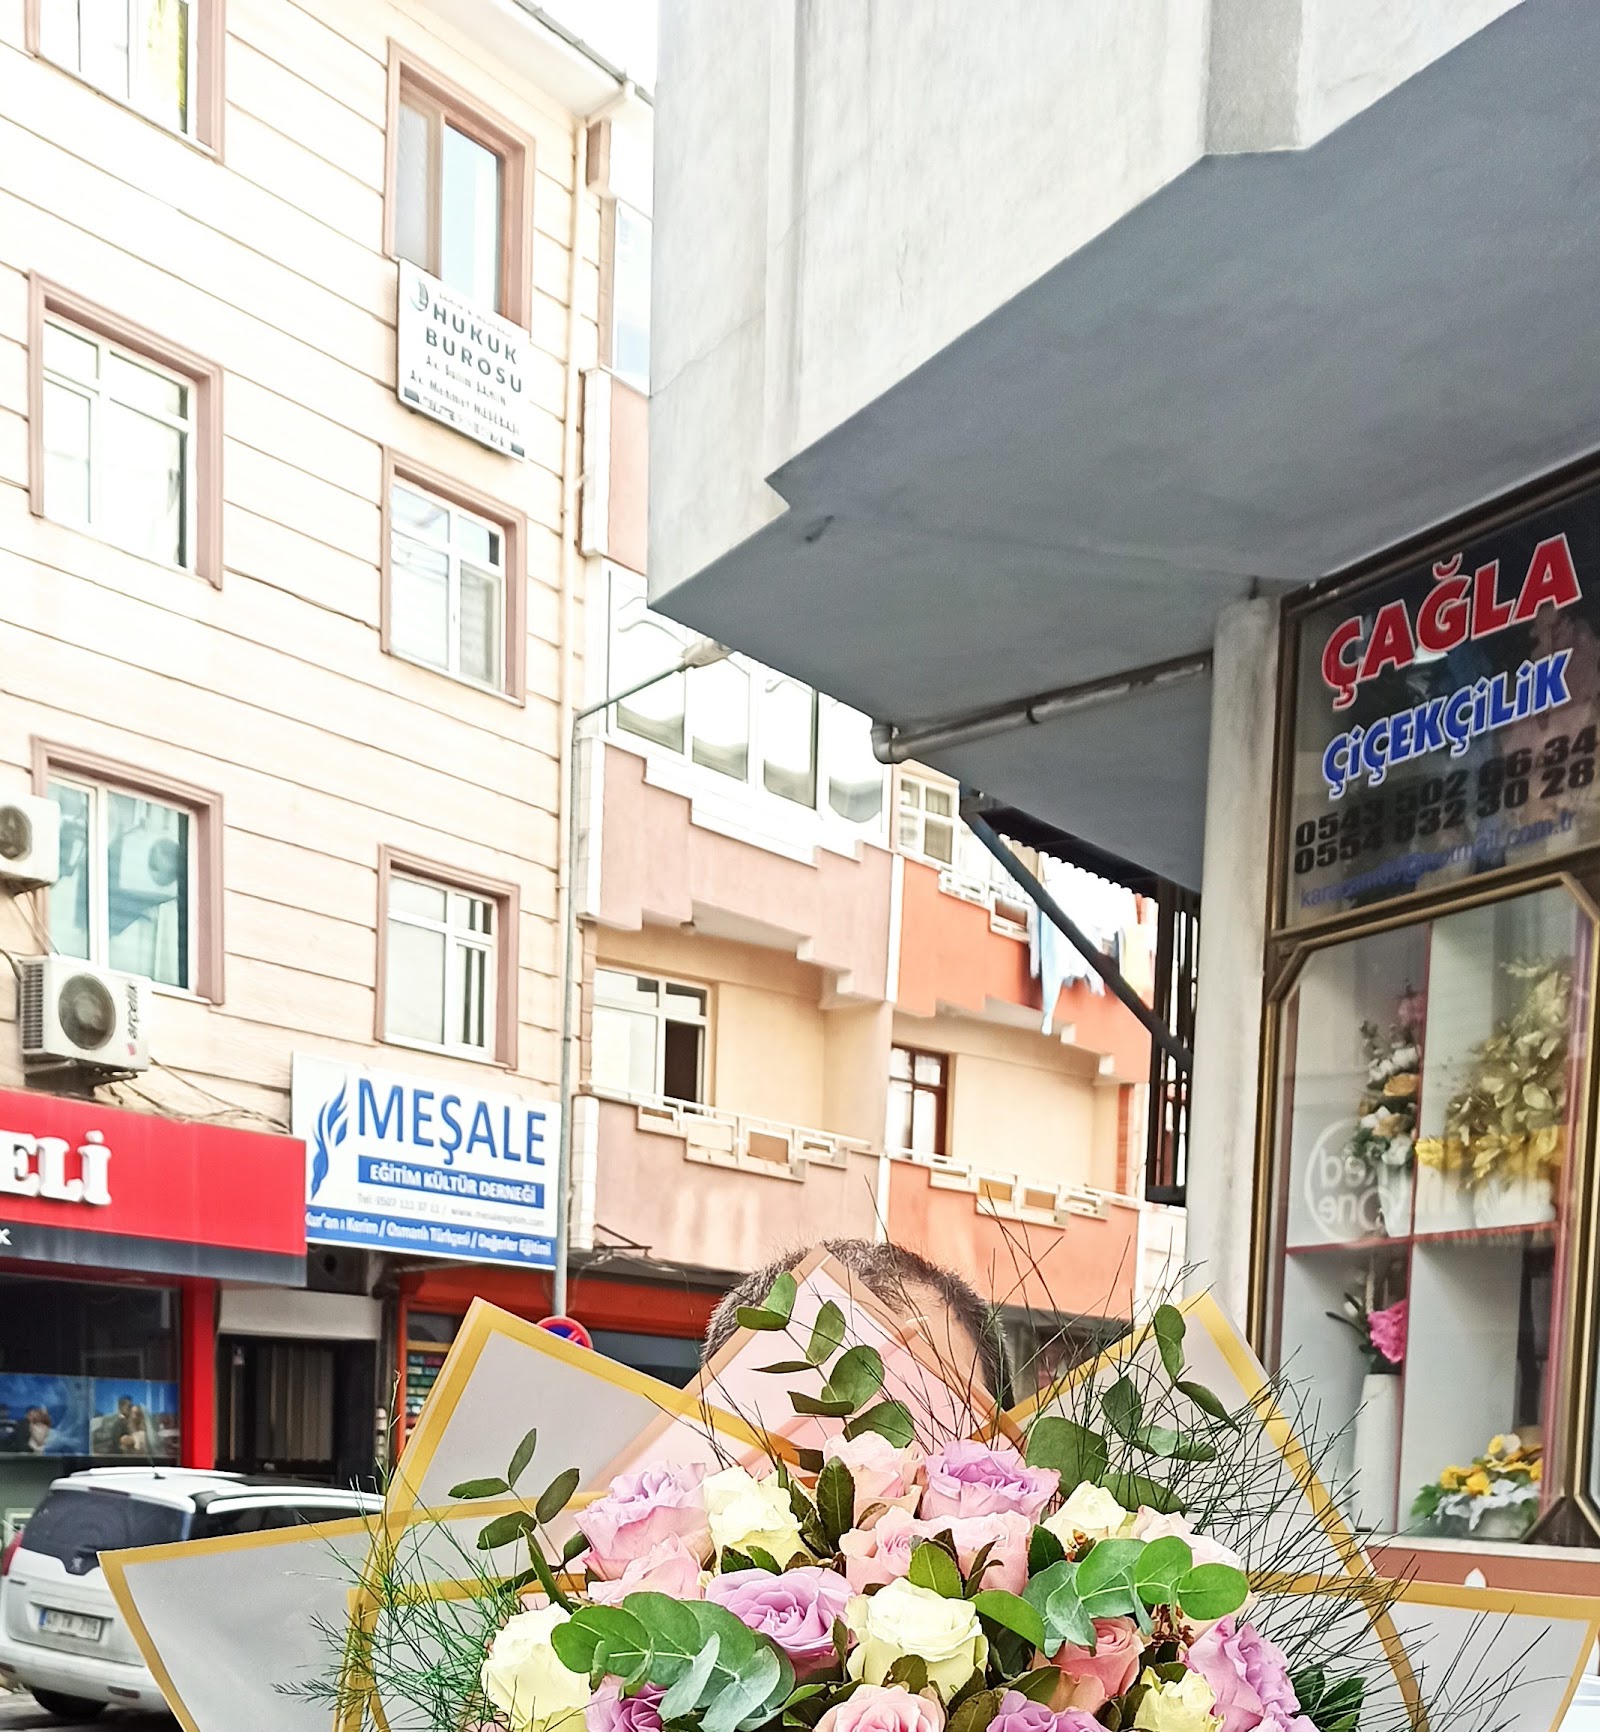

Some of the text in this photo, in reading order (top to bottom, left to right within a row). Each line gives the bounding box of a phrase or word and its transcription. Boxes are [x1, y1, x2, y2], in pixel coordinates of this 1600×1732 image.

[433, 303, 517, 364] HUKUK
[1321, 532, 1582, 711] ÇAĞLA
[1541, 725, 1598, 768] 34
[1540, 757, 1595, 799] 28
[358, 1077, 546, 1166] MEŞALE
[369, 1162, 537, 1205] EĞİTİM KÜLTÜR DERNEĞİ
